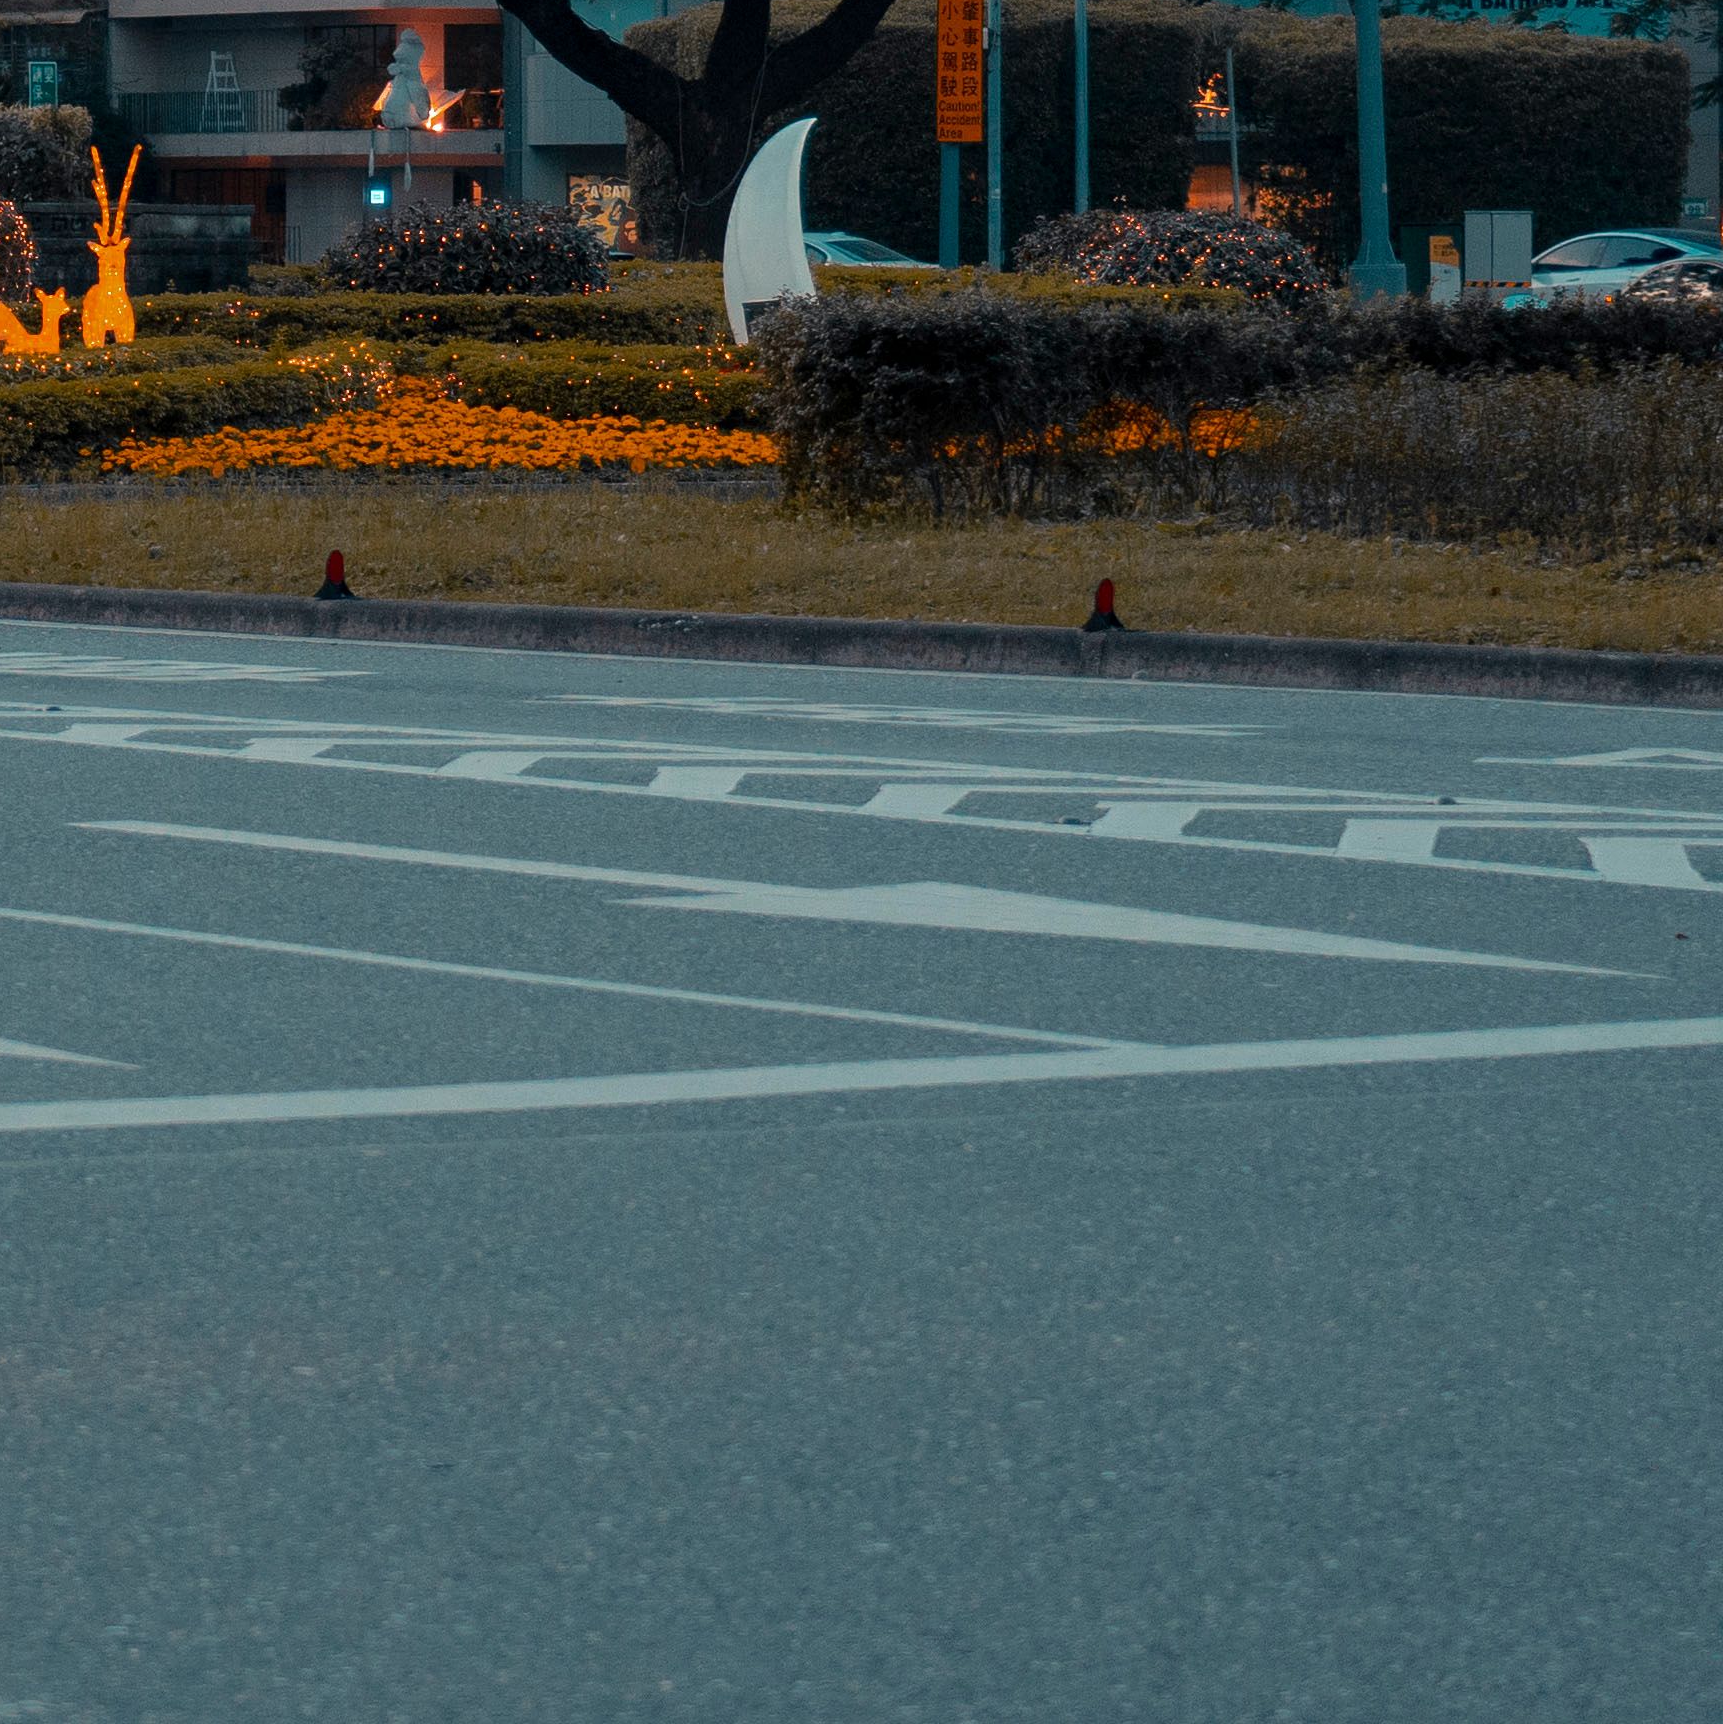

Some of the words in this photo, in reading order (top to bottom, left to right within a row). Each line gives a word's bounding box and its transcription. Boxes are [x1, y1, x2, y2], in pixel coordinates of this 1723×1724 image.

[939, 100, 980, 113] Caution!
[939, 114, 981, 126] Accident
[939, 127, 964, 139] Area
